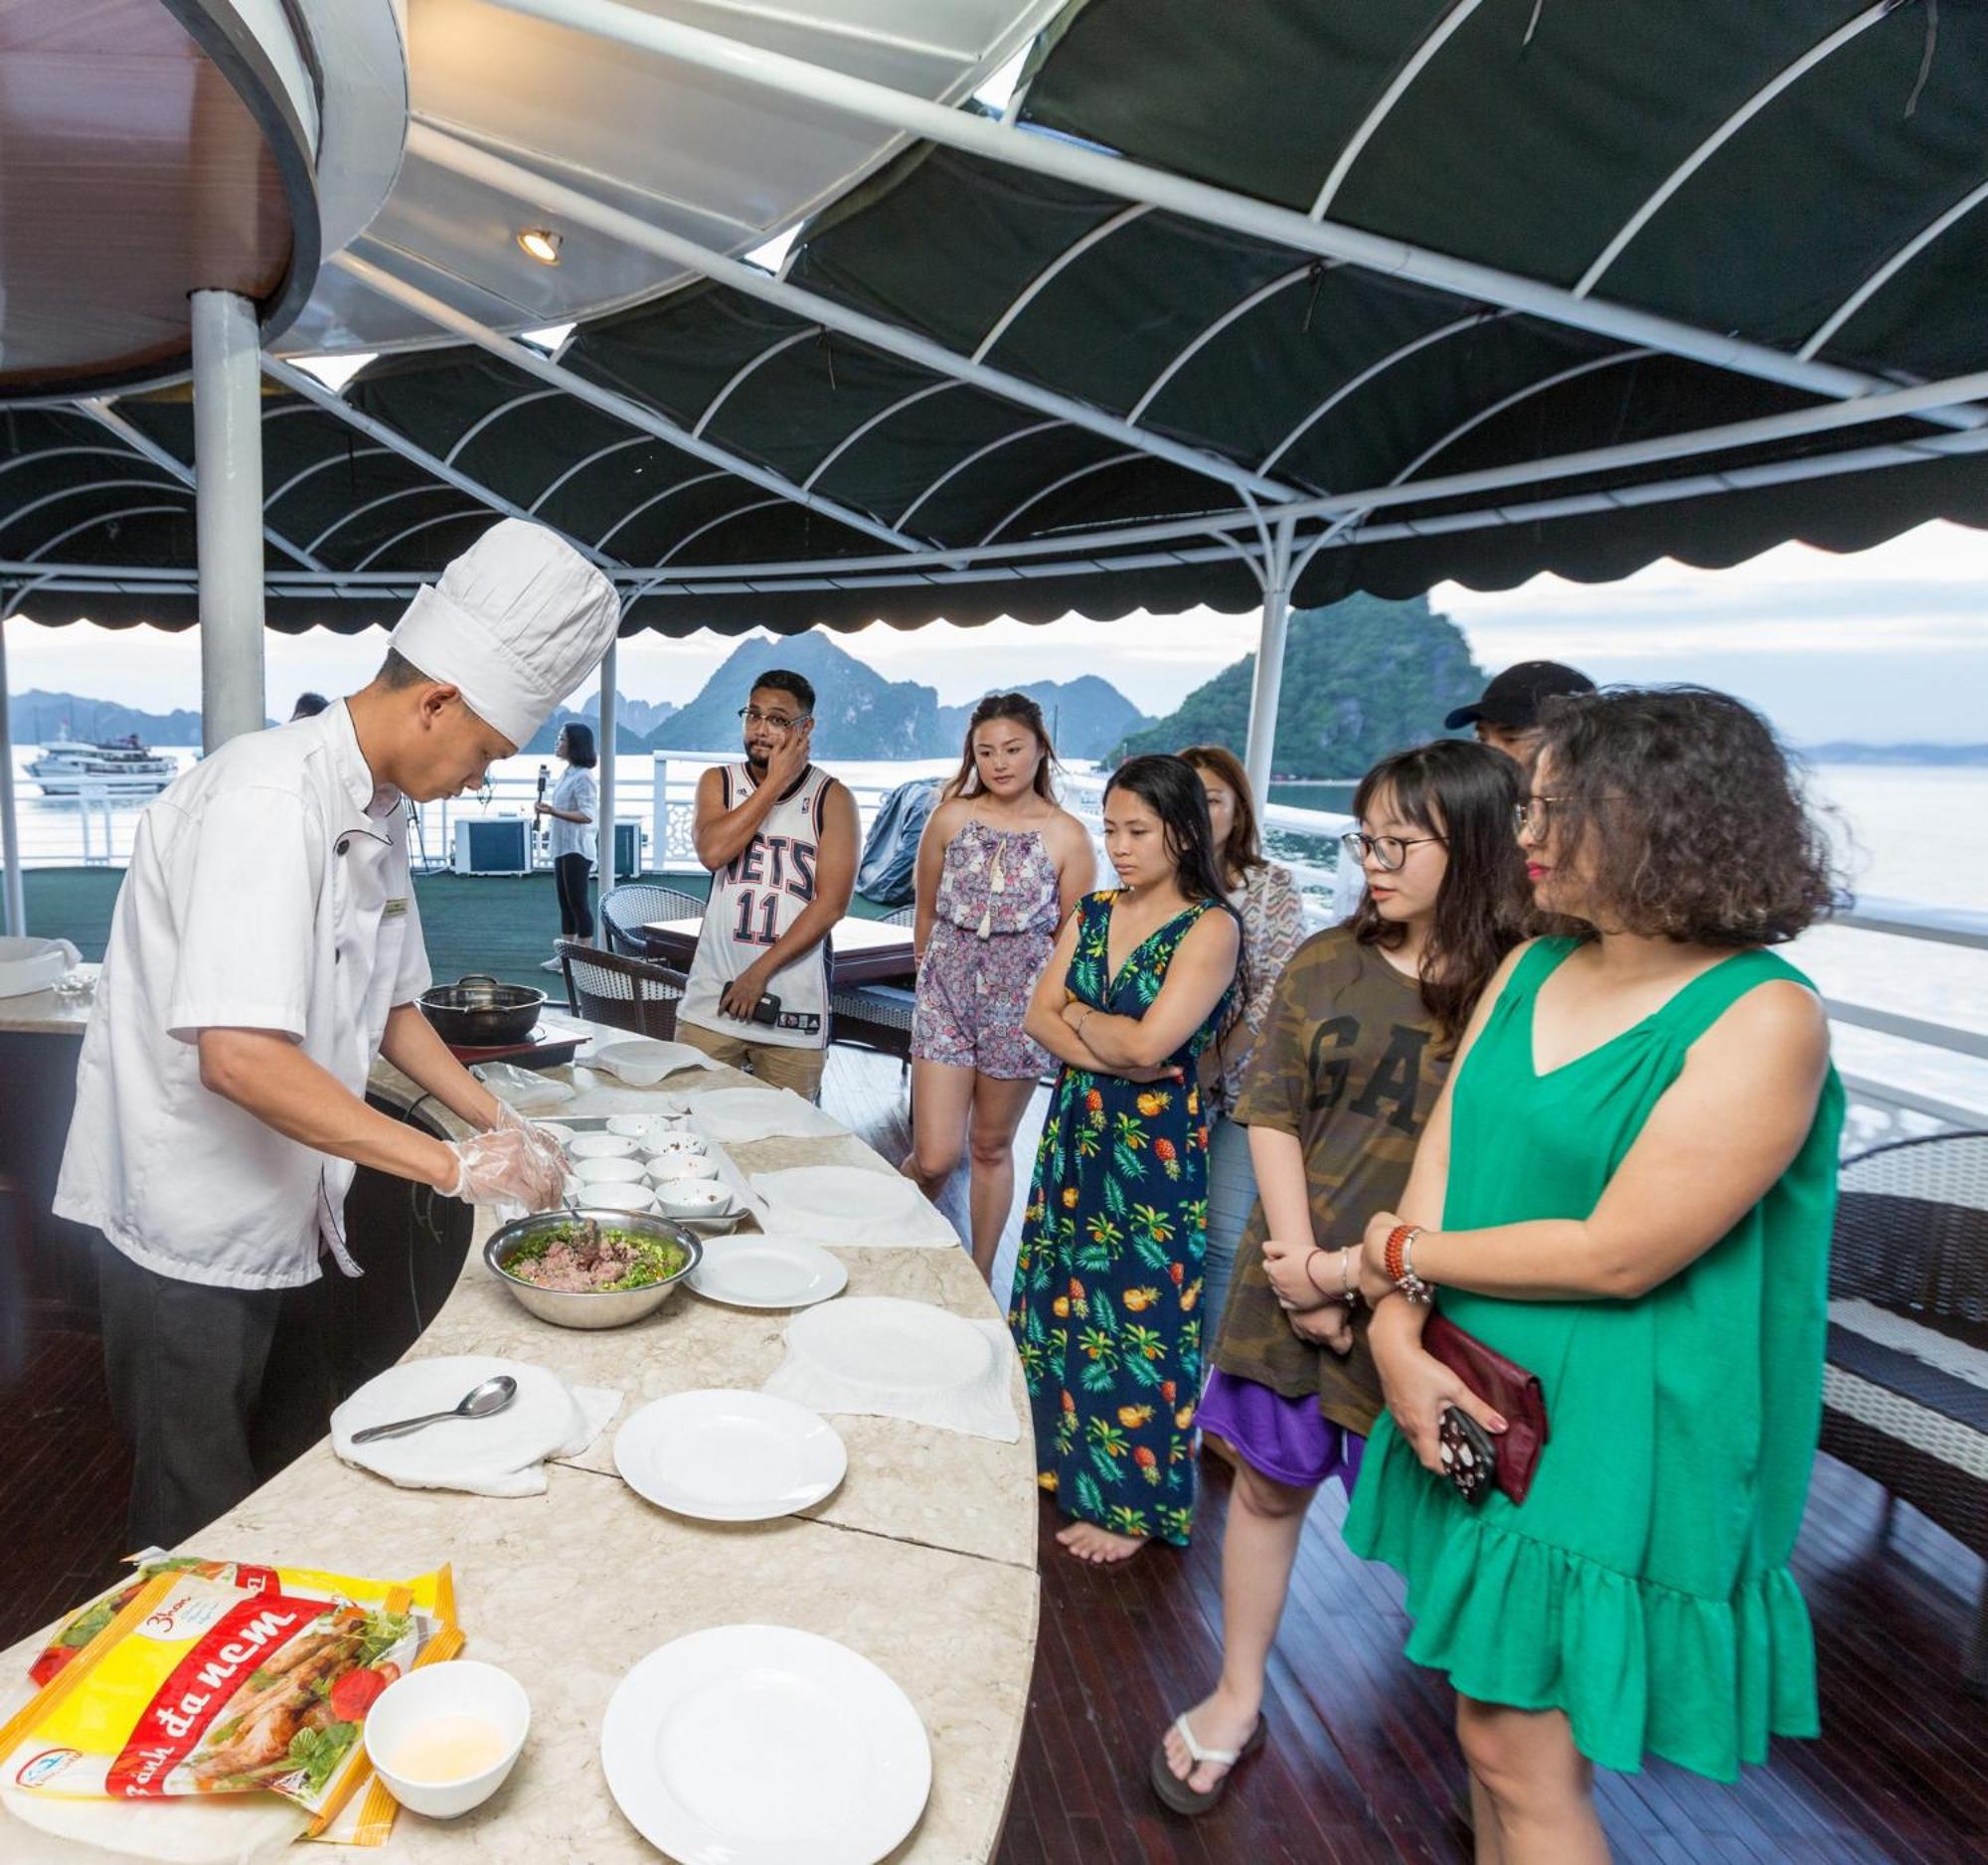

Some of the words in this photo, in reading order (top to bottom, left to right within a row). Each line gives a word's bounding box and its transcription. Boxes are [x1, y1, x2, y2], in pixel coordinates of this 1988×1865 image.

[733, 889, 779, 945] 11
[156, 1692, 211, 1738] đa
[197, 1611, 297, 1688] nem
